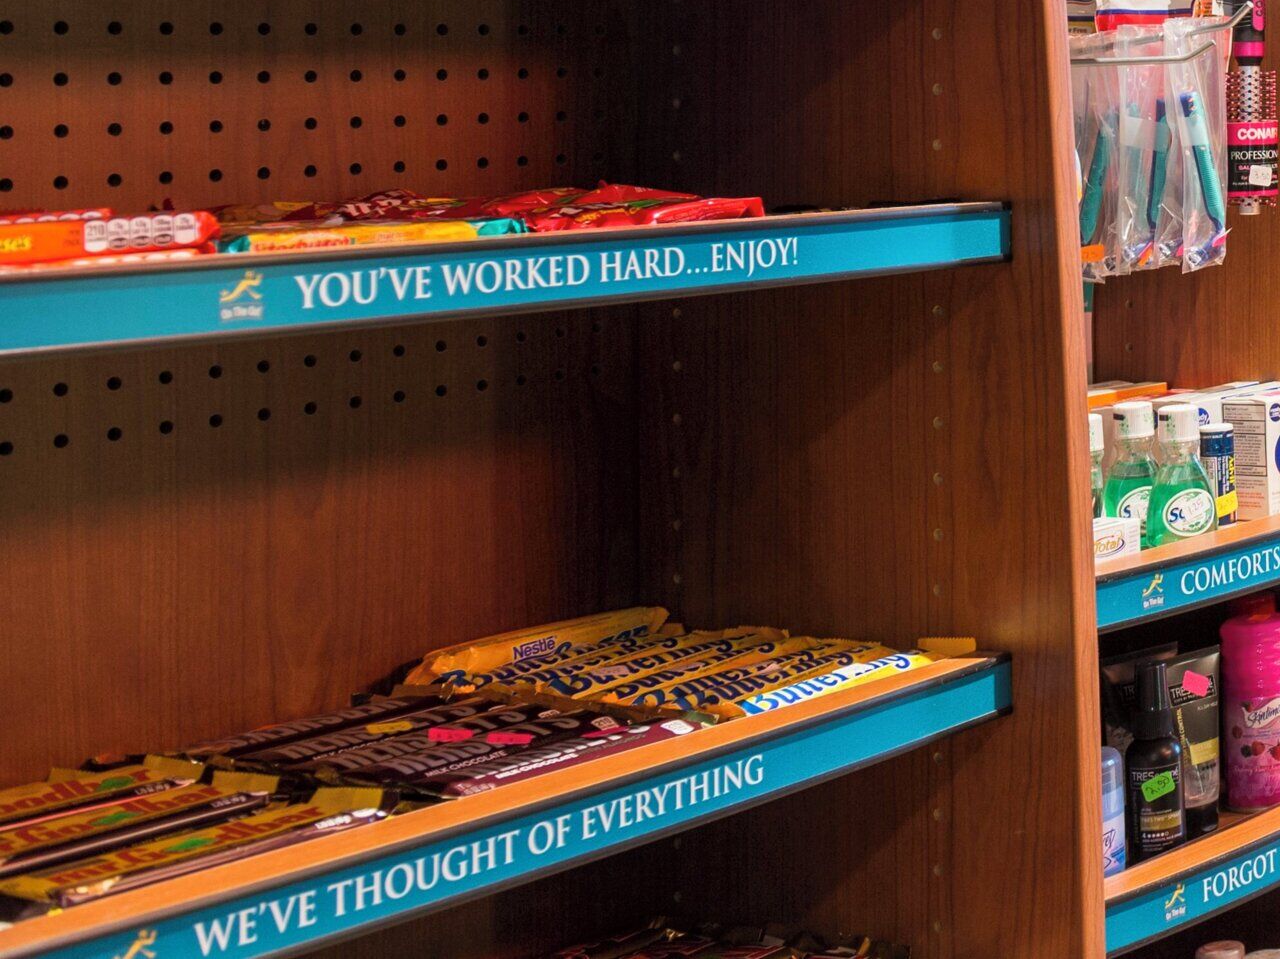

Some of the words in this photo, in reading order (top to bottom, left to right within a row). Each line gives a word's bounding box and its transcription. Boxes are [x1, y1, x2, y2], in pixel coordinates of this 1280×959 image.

[294, 265, 433, 309] YOU'VE
[441, 253, 591, 297] WORKED
[599, 237, 799, 284] HARD...ENJOY!
[1094, 534, 1121, 552] Total
[1180, 545, 1280, 595] COMFORTS
[449, 750, 508, 772] CHOCOLATE
[519, 752, 580, 772] CHOCOLATE
[194, 888, 318, 957] WE'VE
[327, 830, 521, 917] THOUGHT
[526, 814, 573, 855] OF
[581, 754, 765, 840] EVERYTHING
[1202, 848, 1278, 902] FORGOT
